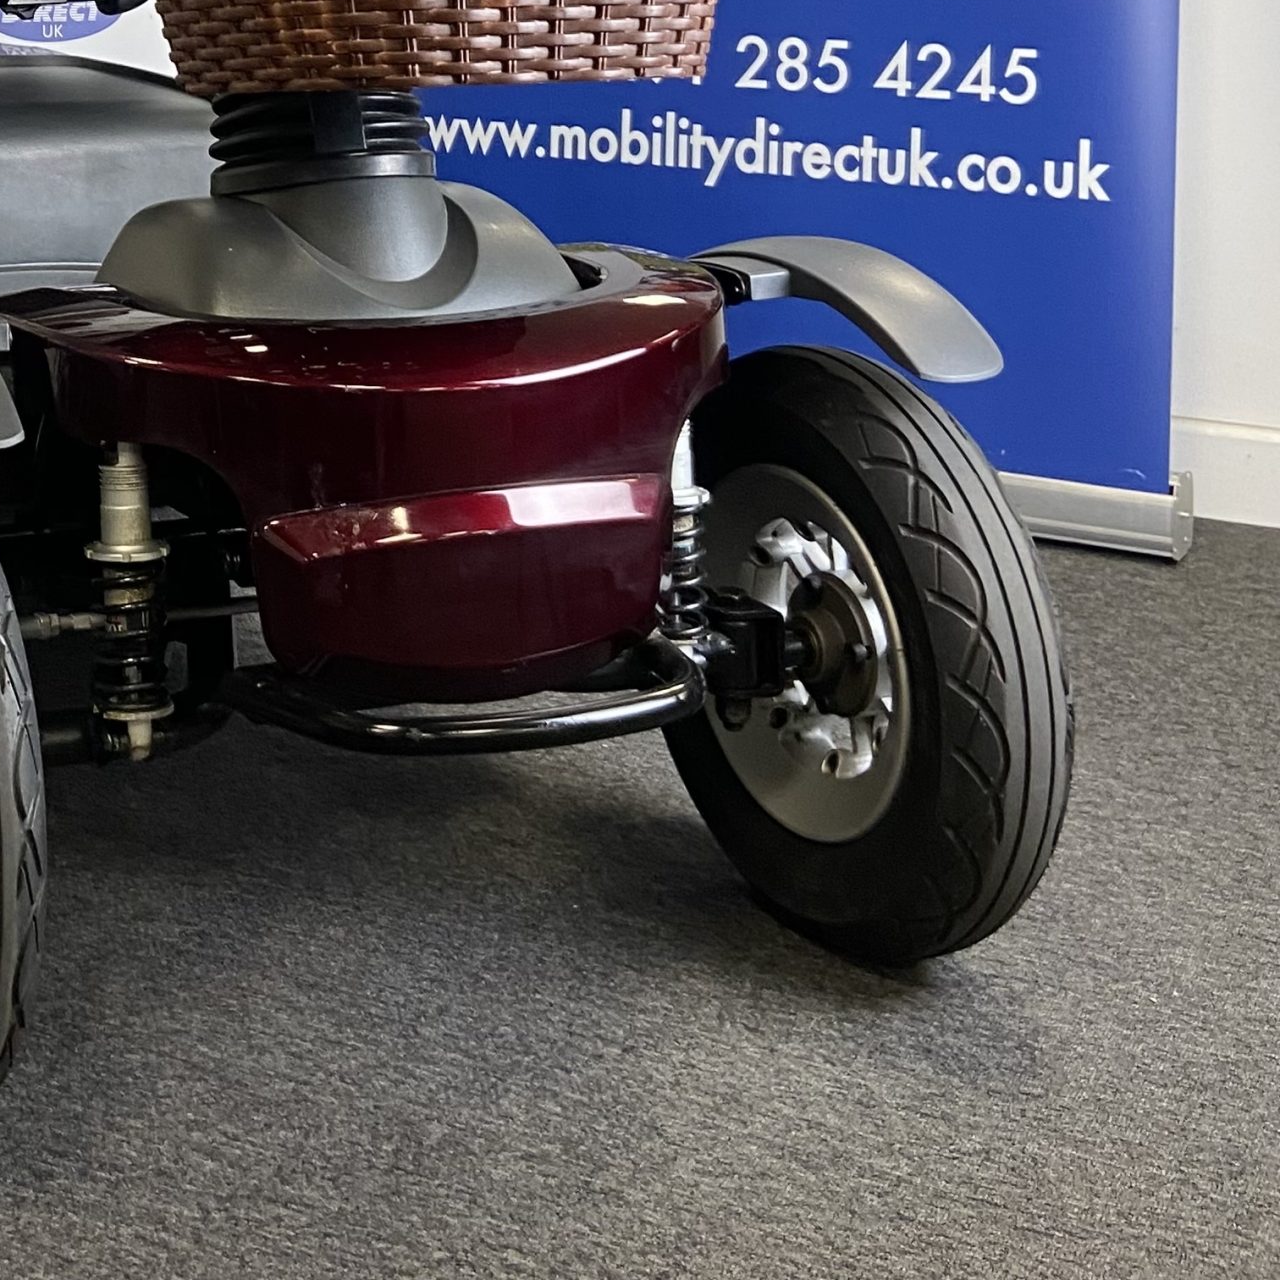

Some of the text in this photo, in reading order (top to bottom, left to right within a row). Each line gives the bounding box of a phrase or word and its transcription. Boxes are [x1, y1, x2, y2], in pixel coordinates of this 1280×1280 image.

[43, 25, 63, 38] UK
[735, 34, 1039, 104] 285 4245
[424, 108, 1111, 202] www.mobilitydirectuk.co.uk
